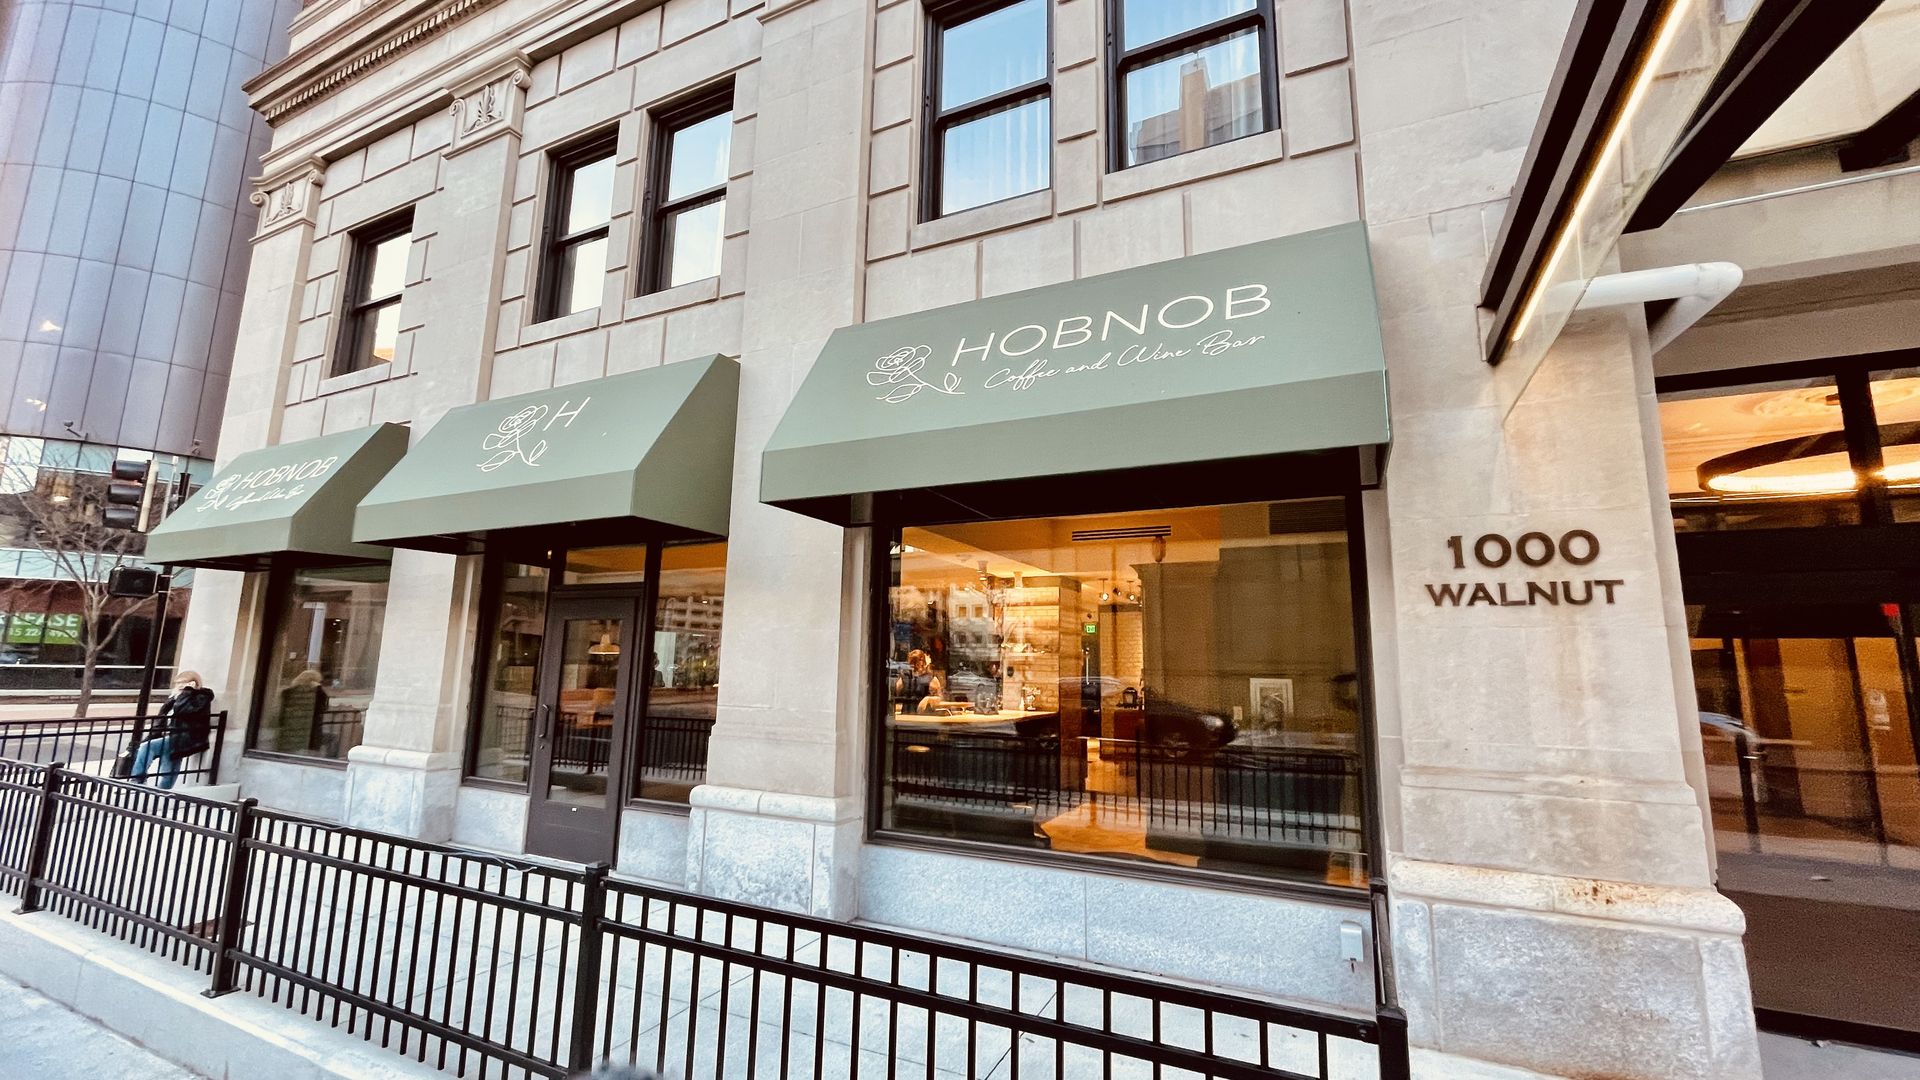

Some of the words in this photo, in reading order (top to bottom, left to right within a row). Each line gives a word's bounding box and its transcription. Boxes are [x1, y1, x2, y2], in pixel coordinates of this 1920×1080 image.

[952, 284, 1271, 366] HOBNOB
[984, 358, 1060, 391] Coffee
[1065, 352, 1112, 374] and
[1117, 343, 1191, 367] Wine
[1197, 329, 1265, 355] Bar
[542, 396, 591, 431] H
[232, 456, 338, 491] HOBNOB
[1447, 529, 1600, 569] 1000
[1424, 579, 1624, 606] WALNUT
[12, 613, 79, 627] LEASE
